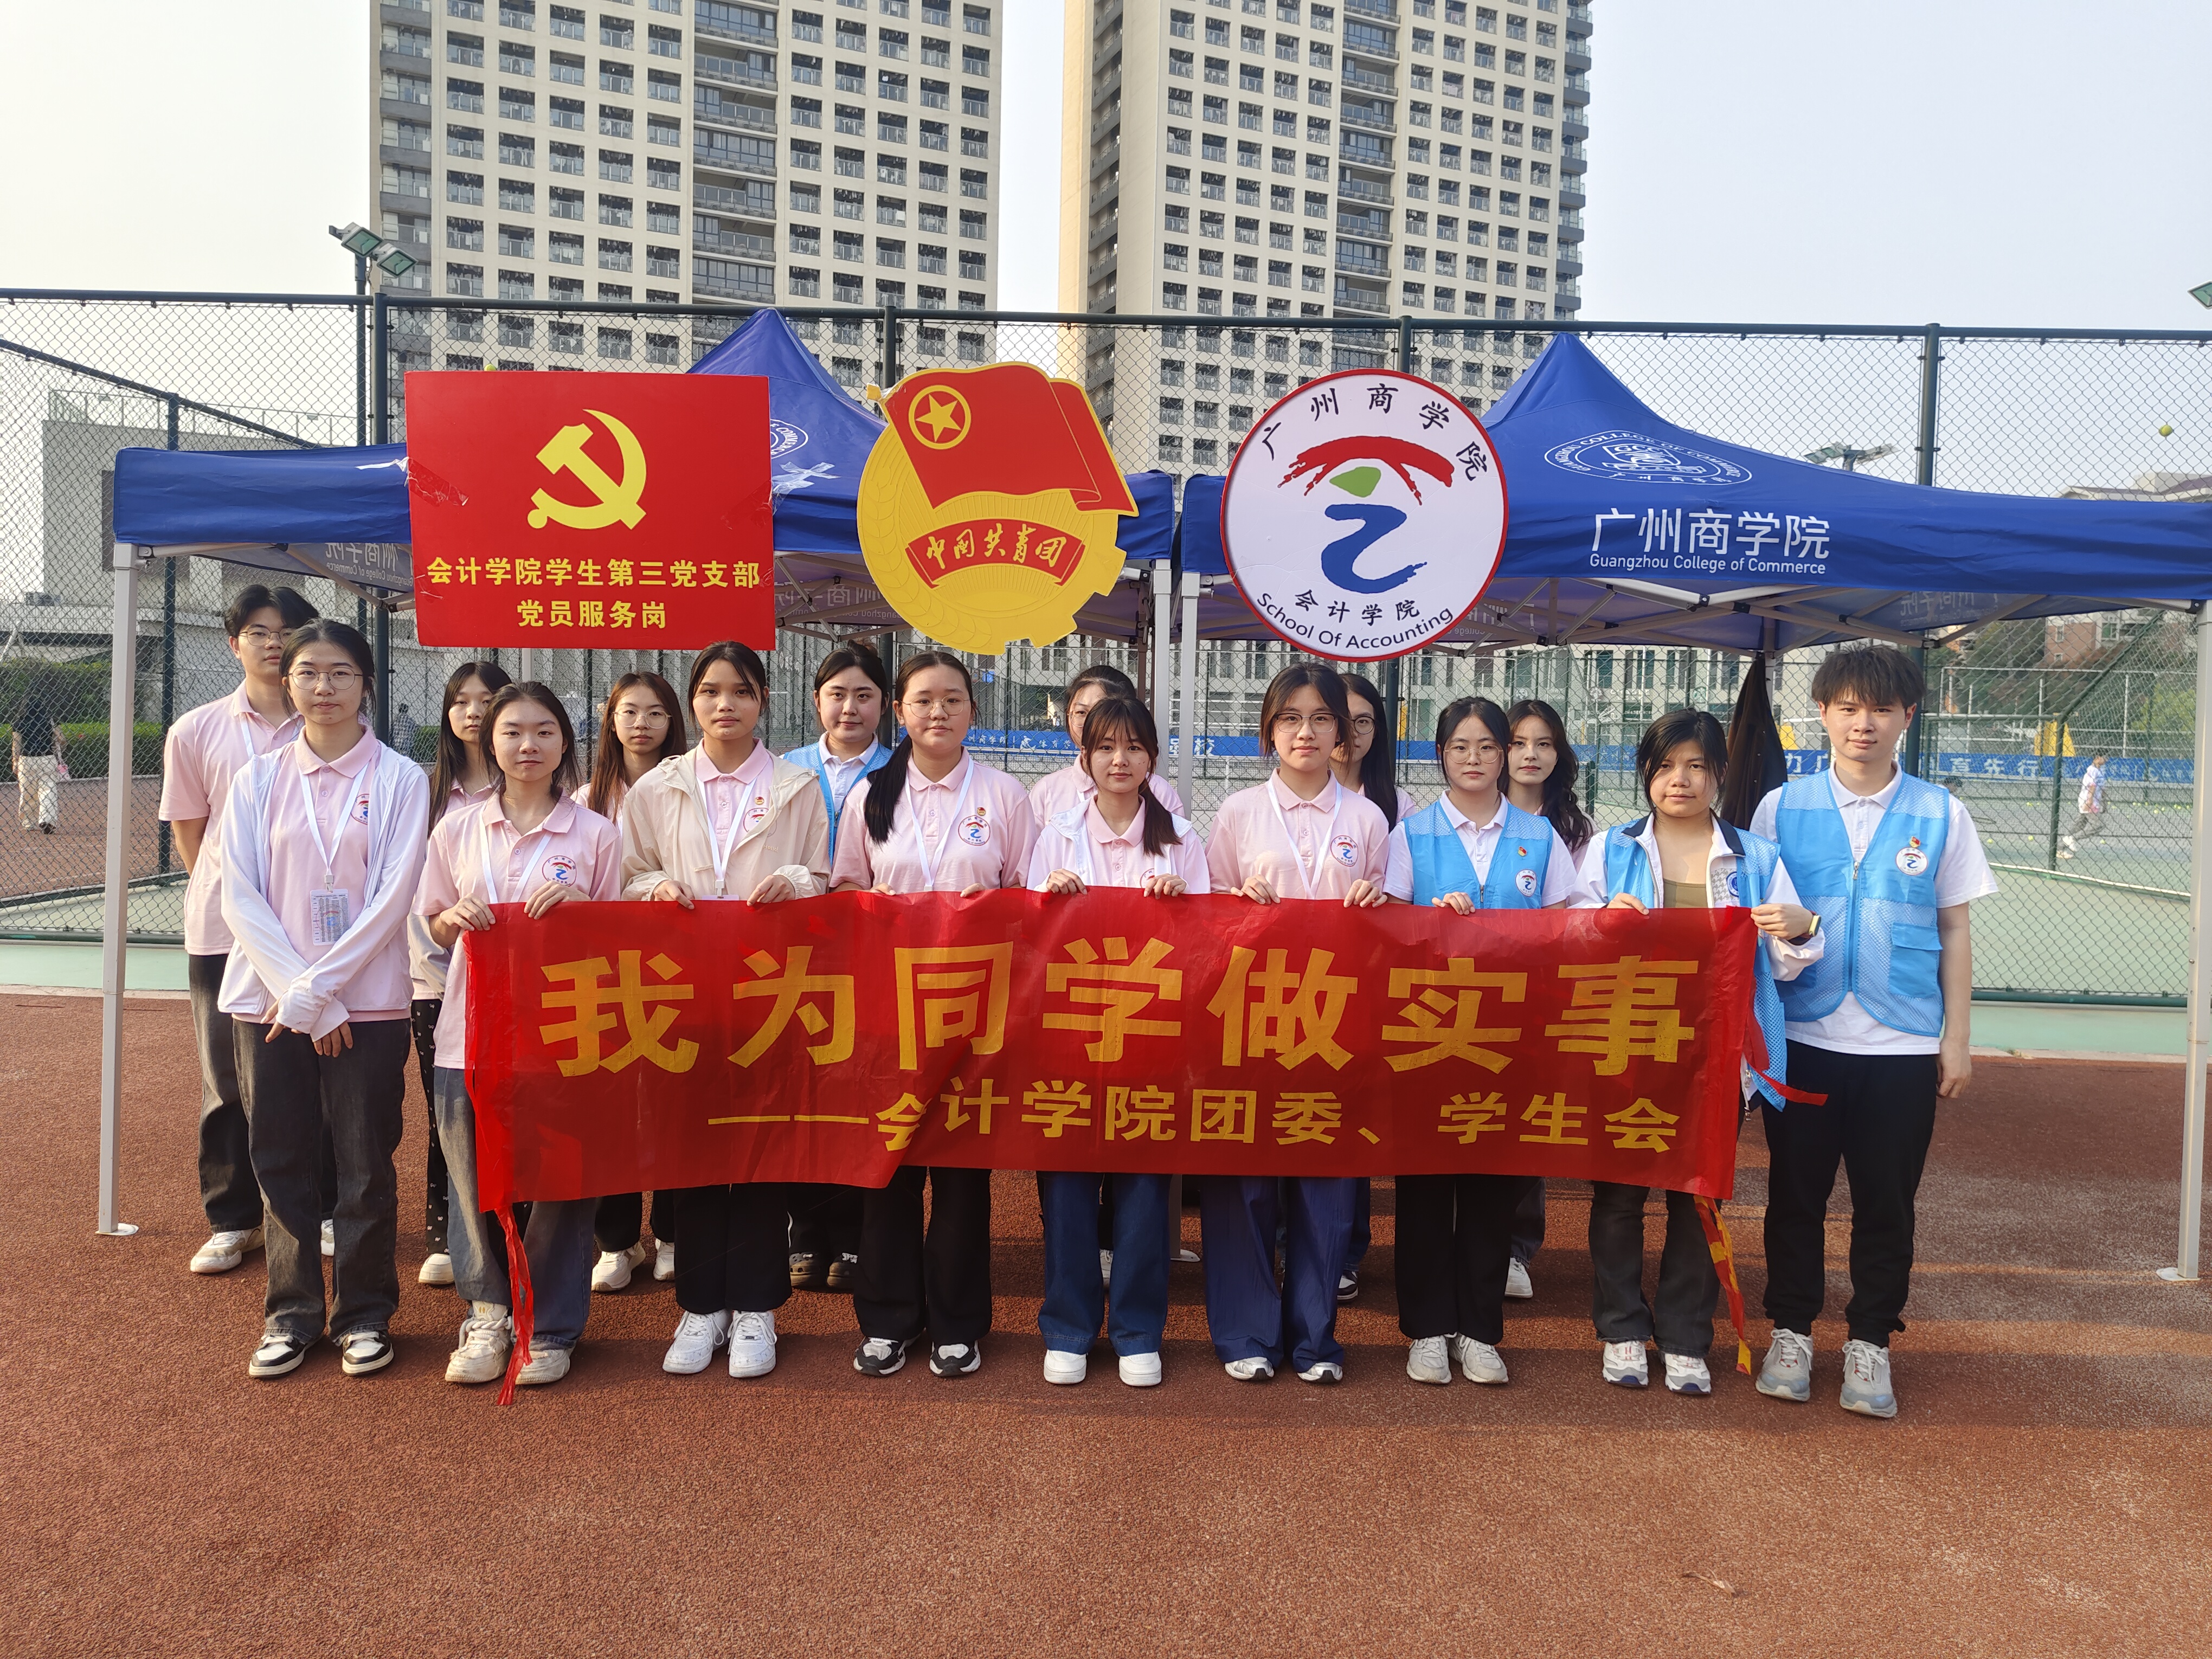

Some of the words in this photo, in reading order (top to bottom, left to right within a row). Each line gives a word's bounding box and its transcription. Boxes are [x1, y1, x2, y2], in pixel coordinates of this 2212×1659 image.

[1262, 383, 1487, 481] 广州商学院
[1591, 507, 1830, 560] 广州商学院
[427, 557, 760, 589] 会计学院学生第三党支部
[1590, 553, 1669, 571] Guangzhou
[1673, 555, 1726, 574] College
[1730, 557, 1745, 571] of
[1747, 557, 1827, 575] Commerce
[517, 599, 666, 629] 党员服务岗
[1257, 593, 1315, 639] School
[1319, 631, 1342, 646] Of
[1345, 607, 1454, 649] Accounting
[1294, 589, 1420, 626] 会计学院
[539, 936, 1699, 1077] 我为同学做实事
